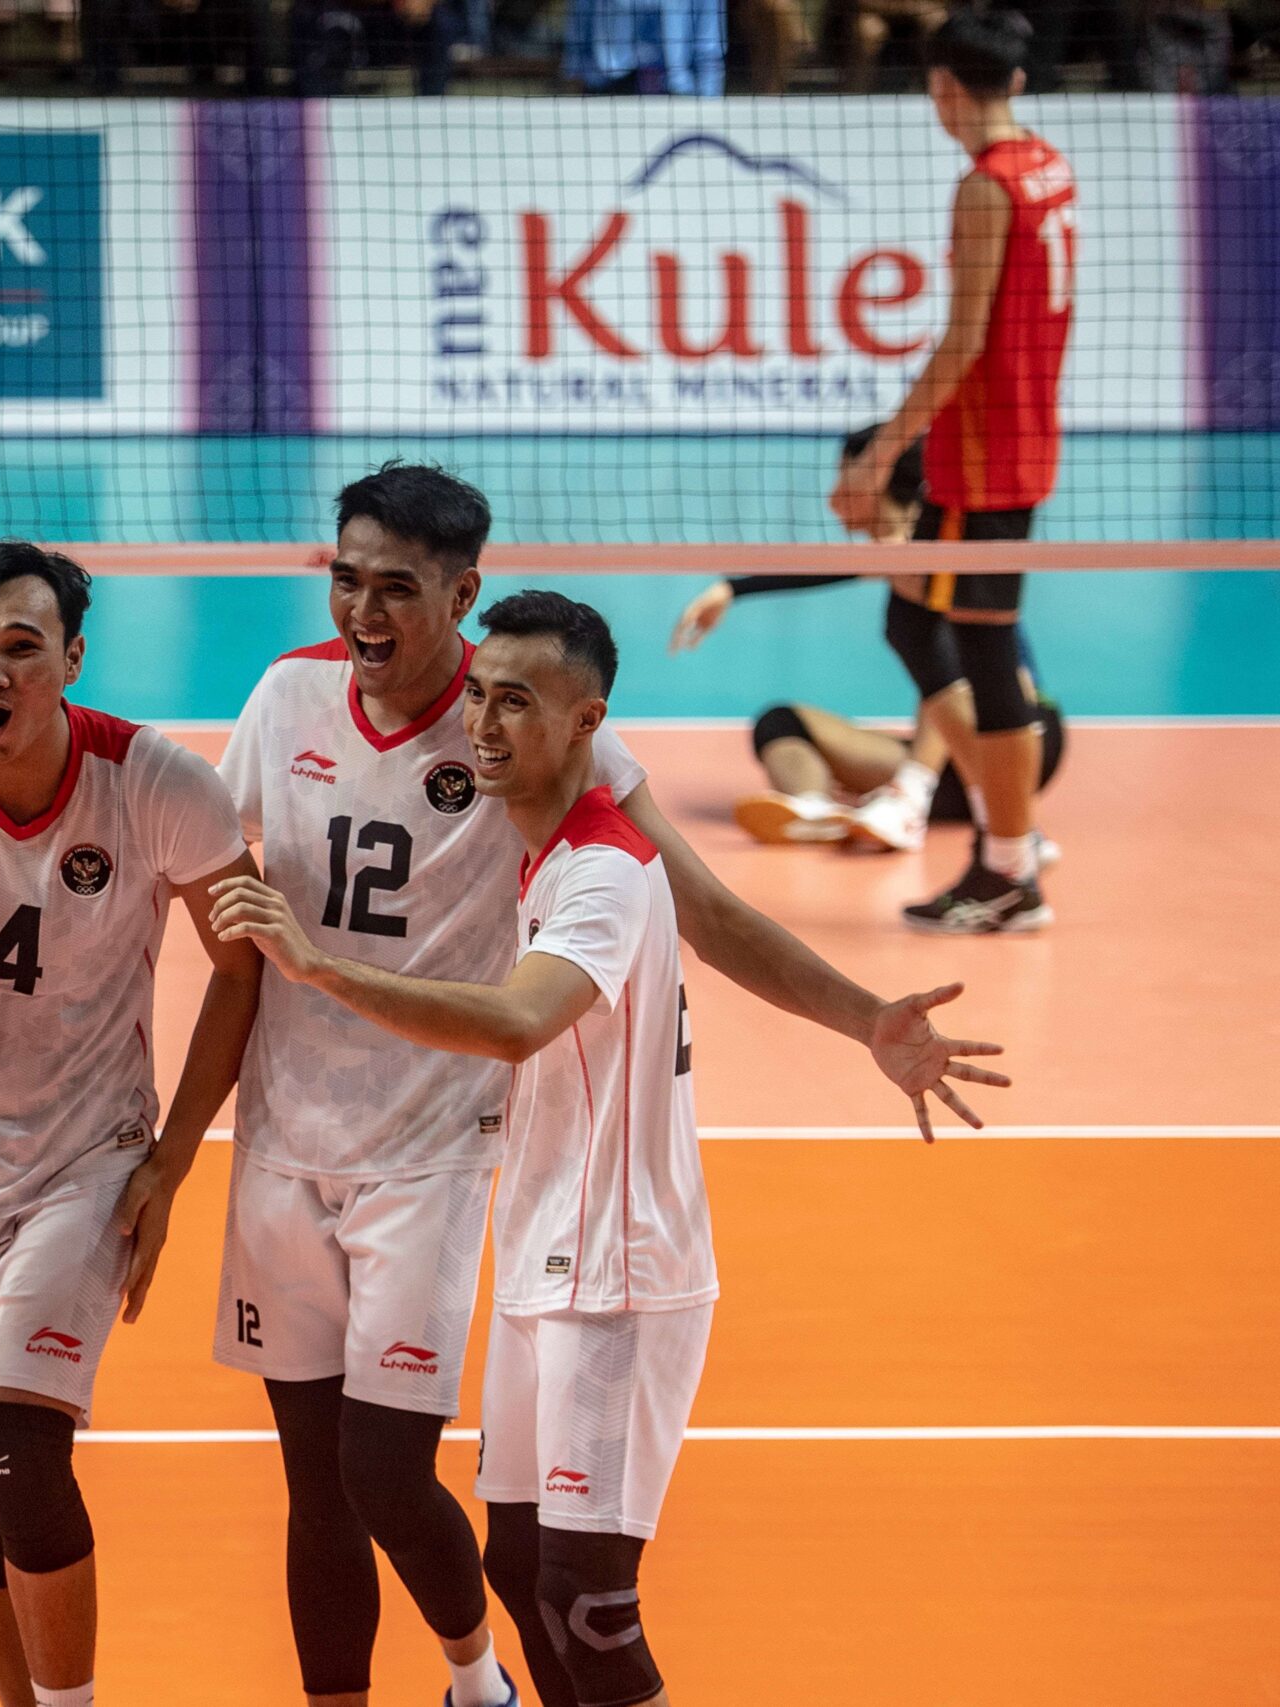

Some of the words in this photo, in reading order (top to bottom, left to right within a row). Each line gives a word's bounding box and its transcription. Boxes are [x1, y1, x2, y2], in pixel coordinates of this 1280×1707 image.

[430, 206, 488, 356] eau
[517, 196, 953, 361] Kule
[433, 368, 650, 404] NATURAL
[290, 764, 336, 785] LI-NING
[321, 815, 413, 938] 12
[236, 1298, 263, 1349] 12
[25, 1343, 82, 1363] LI-NING
[380, 1358, 438, 1375] LI-NING
[546, 1482, 590, 1495] LI-NING
